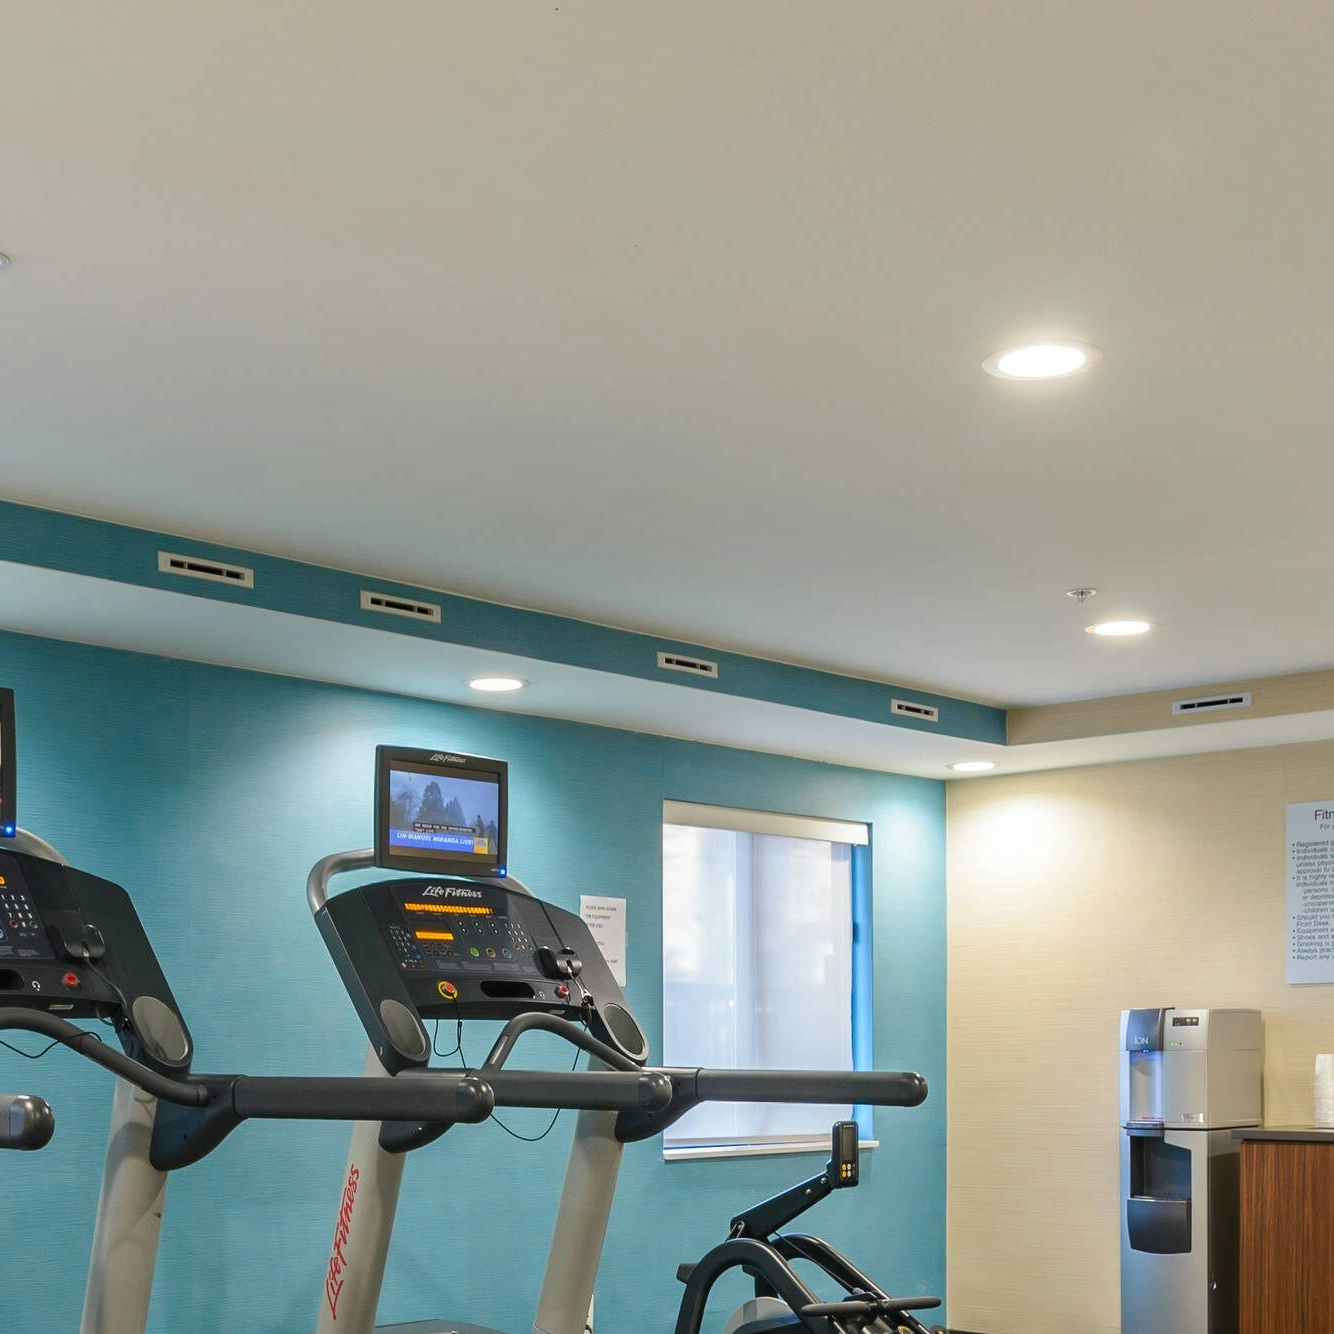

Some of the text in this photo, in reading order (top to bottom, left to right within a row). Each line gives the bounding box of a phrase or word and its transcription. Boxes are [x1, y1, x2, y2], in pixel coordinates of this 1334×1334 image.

[422, 886, 483, 898] Life Fitness
[326, 1163, 359, 1320] Life Fitness
